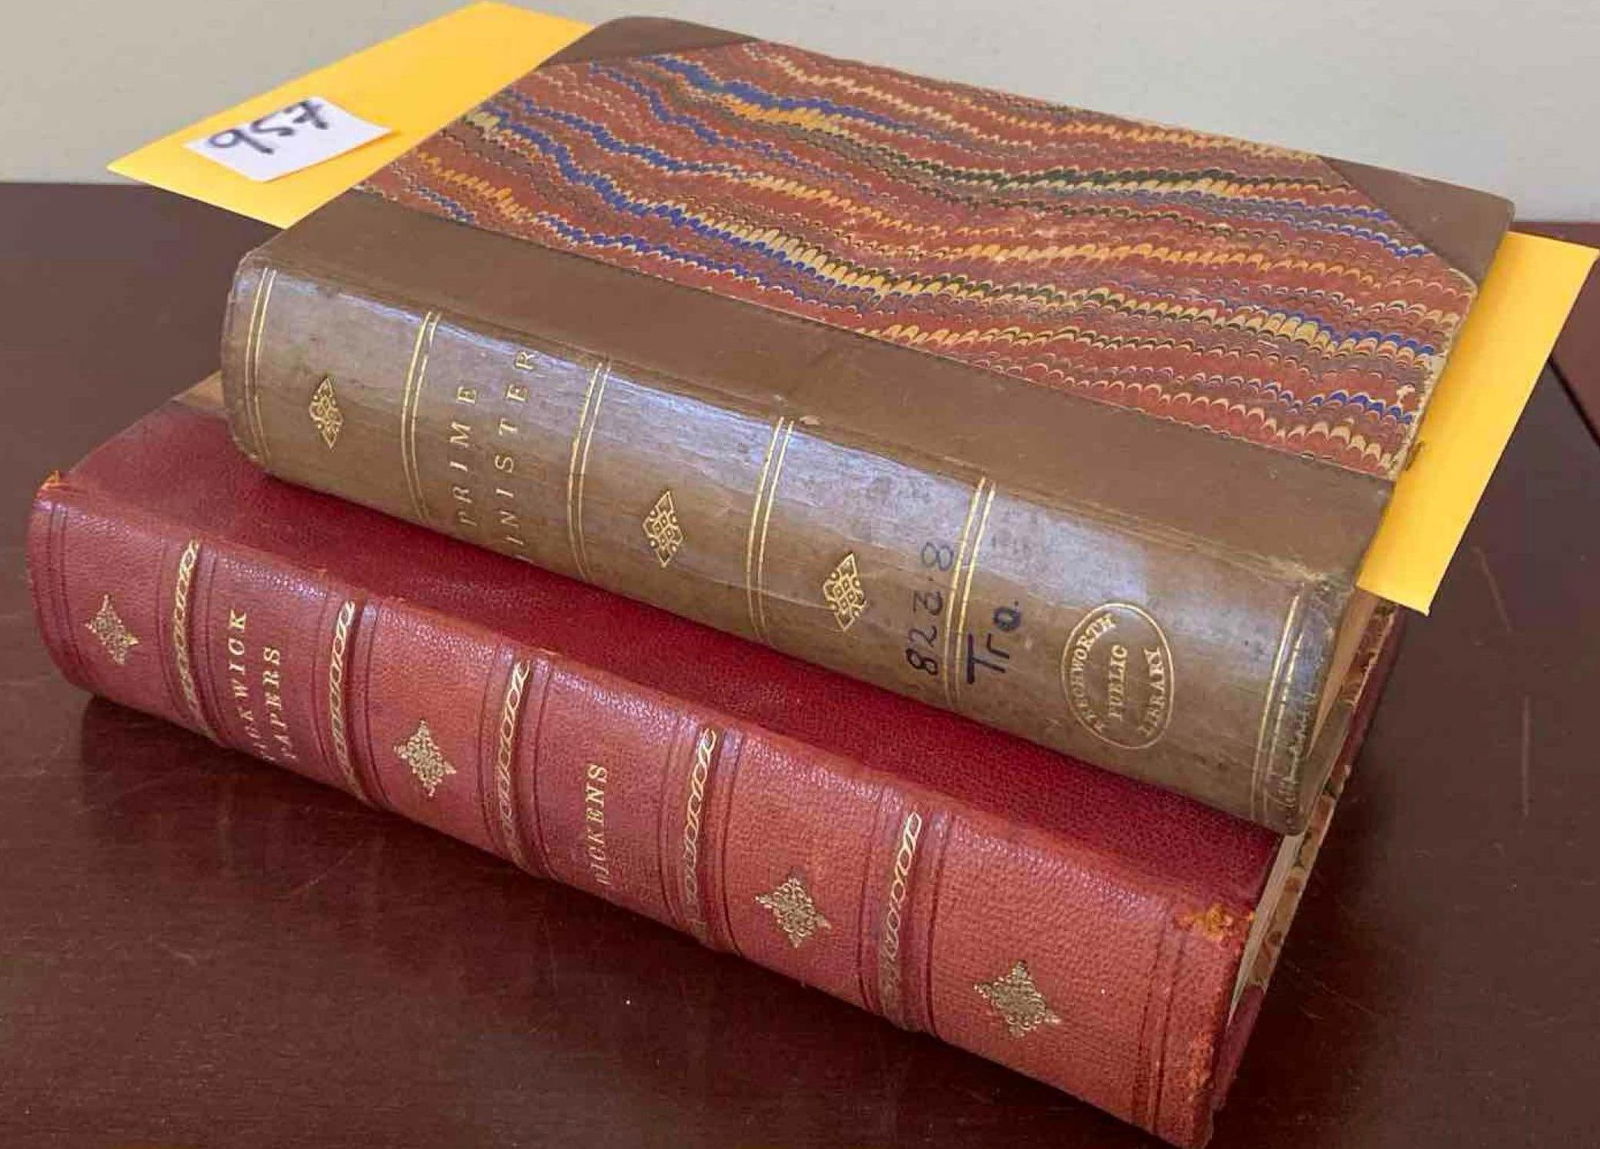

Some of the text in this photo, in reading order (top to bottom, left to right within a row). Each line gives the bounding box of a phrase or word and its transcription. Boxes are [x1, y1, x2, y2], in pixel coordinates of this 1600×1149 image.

[208, 100, 329, 155] 957
[449, 386, 478, 527] PRIME
[495, 350, 537, 564] INISTER
[263, 646, 297, 760] PAPERS
[1107, 644, 1128, 722] PUBLIC
[1137, 647, 1166, 737] LIBRARY
